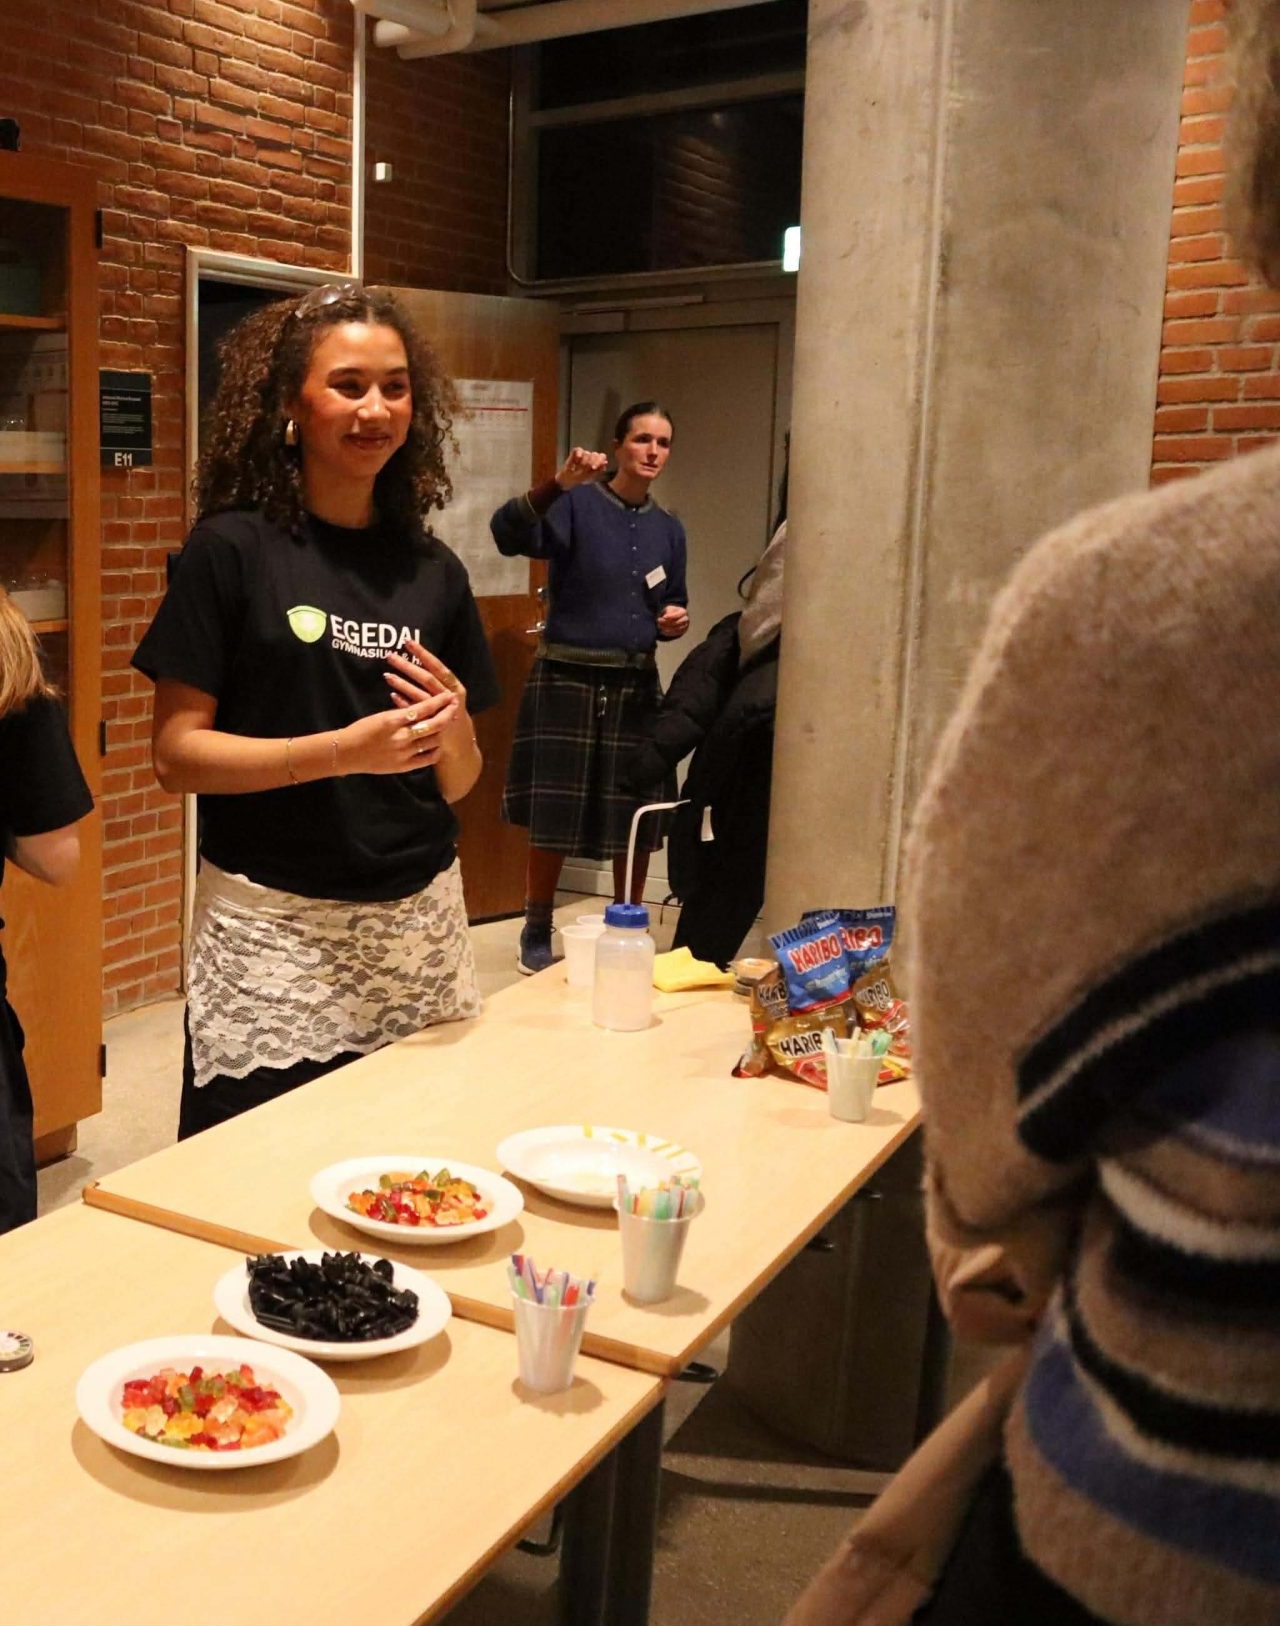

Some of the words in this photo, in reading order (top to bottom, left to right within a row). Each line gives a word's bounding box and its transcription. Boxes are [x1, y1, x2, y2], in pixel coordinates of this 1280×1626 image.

[114, 452, 133, 467] E11
[787, 933, 843, 975] HARIBO
[779, 1031, 824, 1057] HARIB
